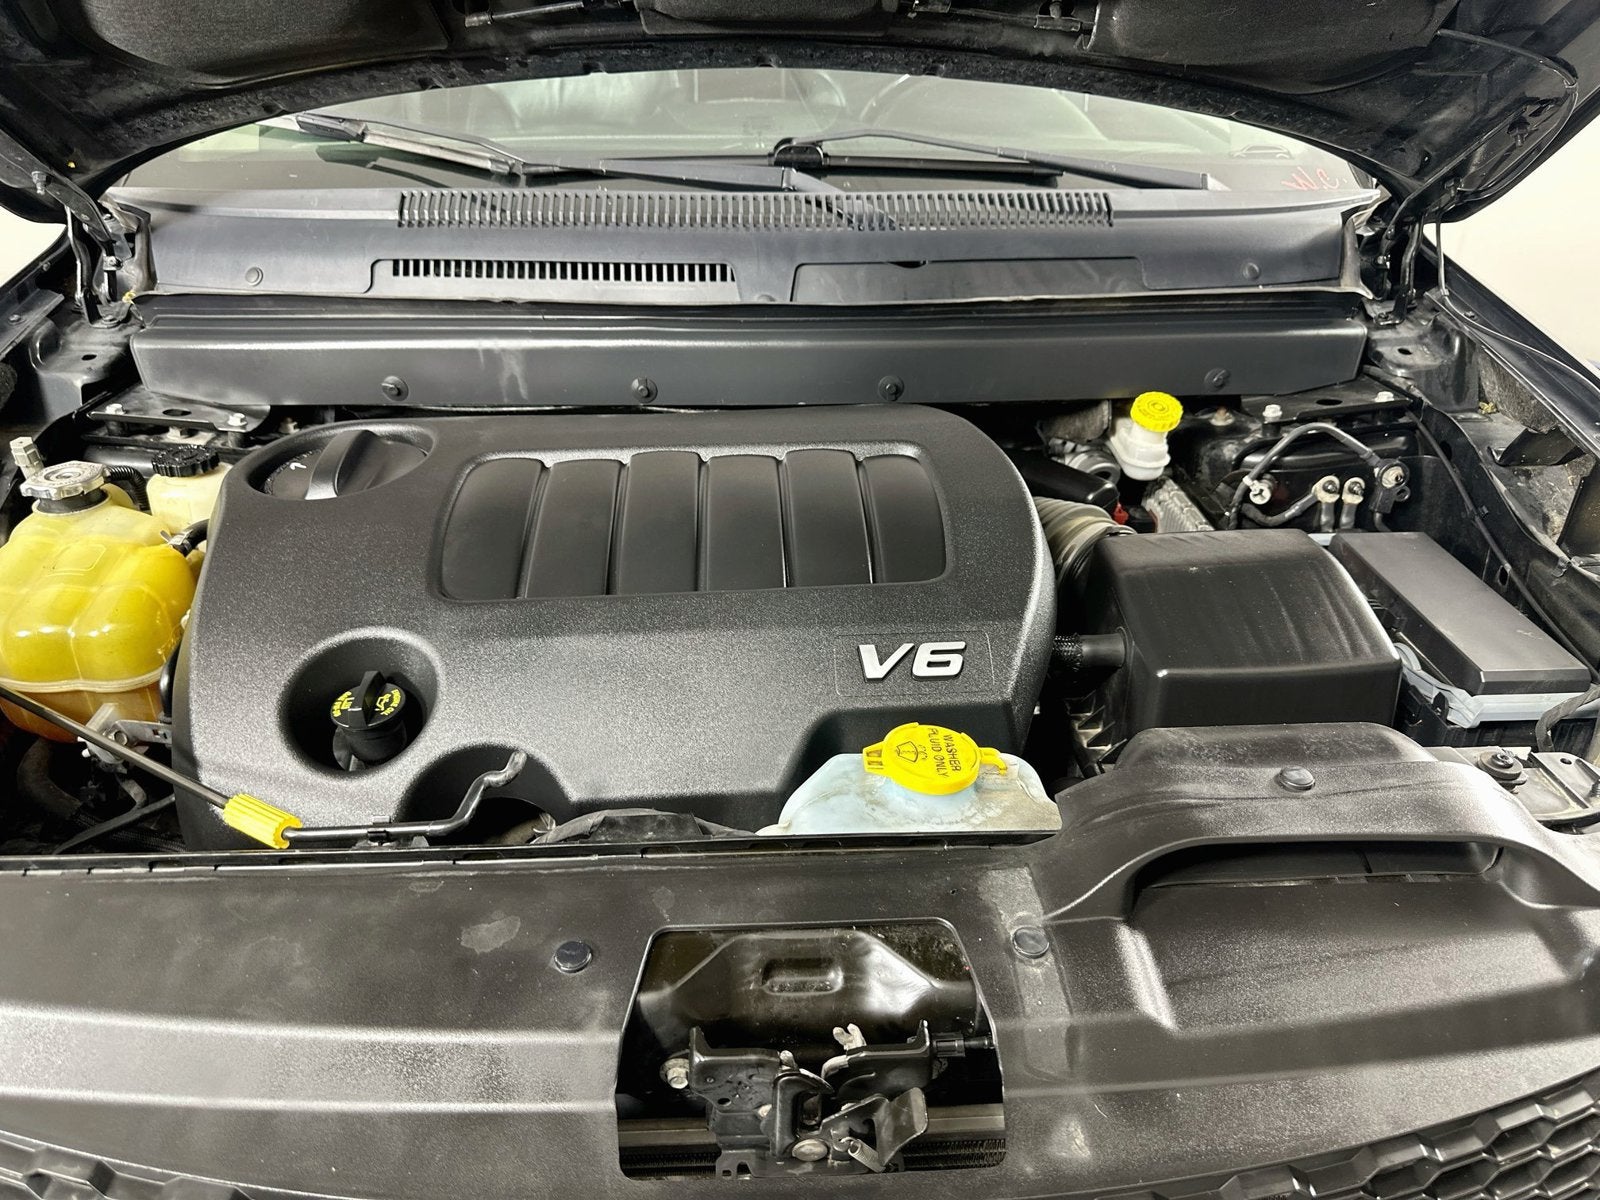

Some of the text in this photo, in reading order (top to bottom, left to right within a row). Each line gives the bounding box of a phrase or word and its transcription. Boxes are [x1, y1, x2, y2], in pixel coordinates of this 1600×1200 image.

[858, 641, 966, 681] V6
[928, 728, 950, 778] FLUID ONLY
[943, 734, 962, 771] WASHER
